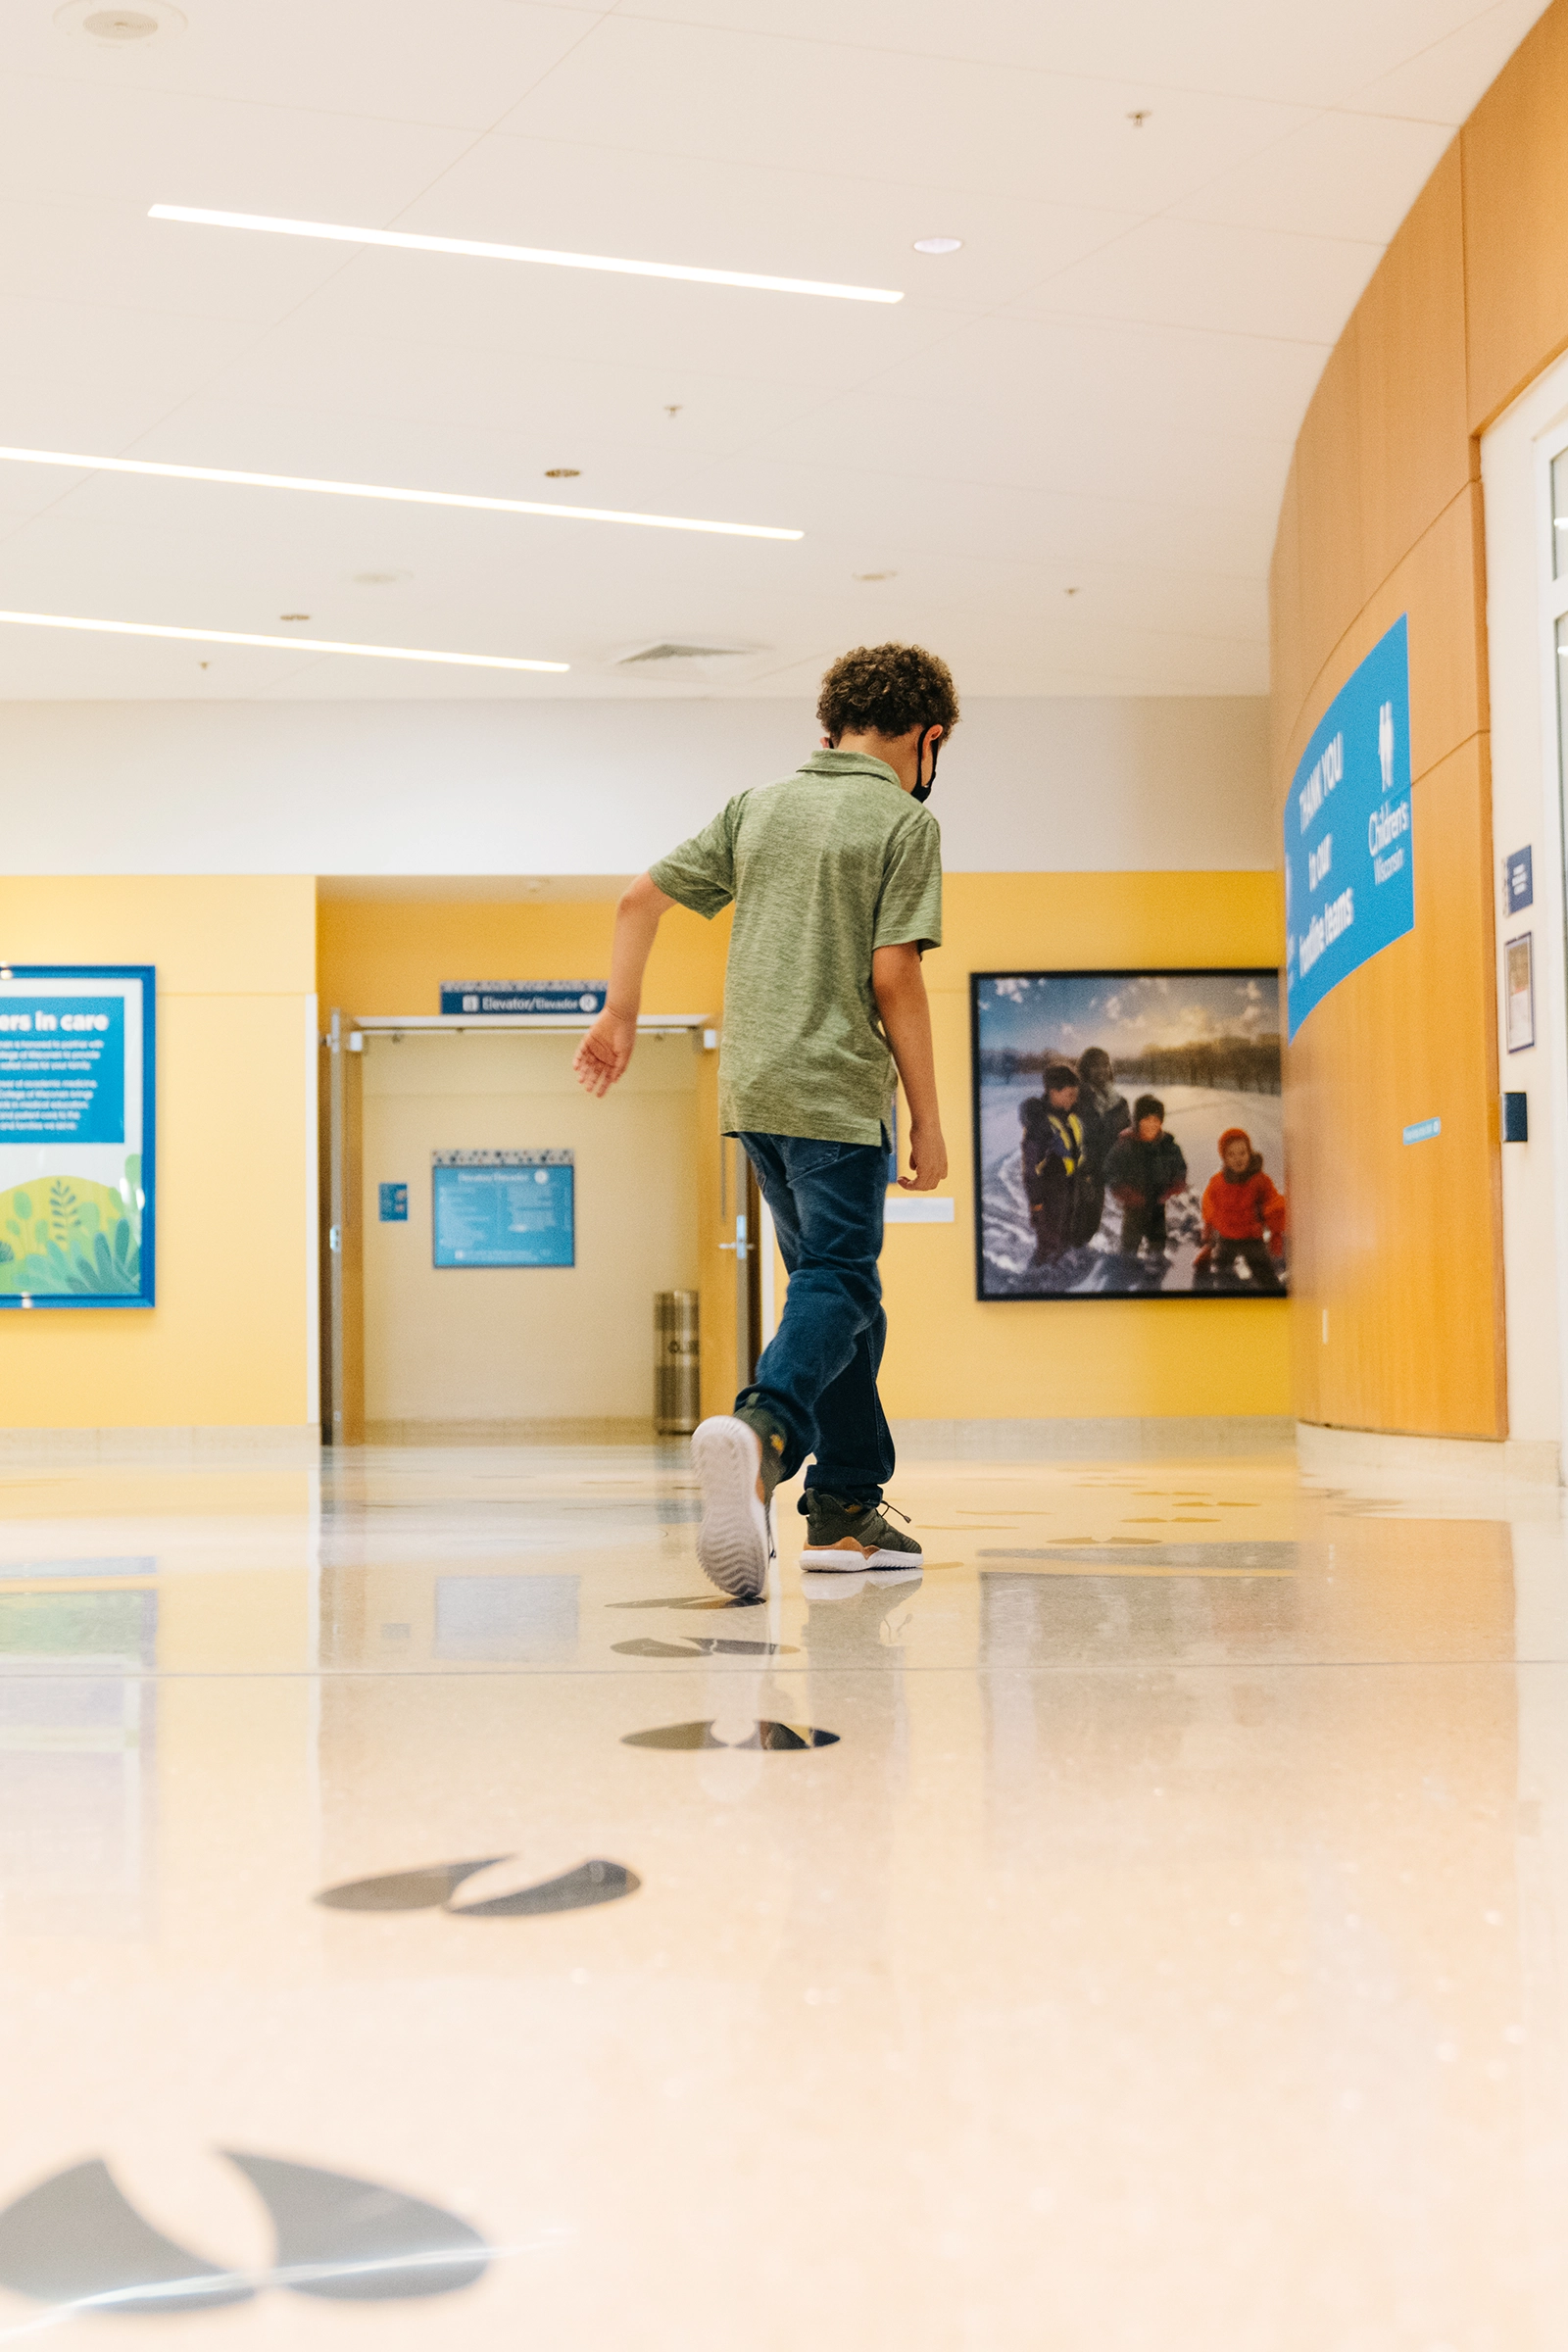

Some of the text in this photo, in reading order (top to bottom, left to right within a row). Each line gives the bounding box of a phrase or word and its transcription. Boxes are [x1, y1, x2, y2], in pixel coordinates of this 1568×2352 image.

[1321, 731, 1344, 797] YOU
[1368, 801, 1409, 858] Children's
[1374, 846, 1404, 886] Wisconsin
[34, 1010, 58, 1032] in
[60, 1013, 110, 1032] care
